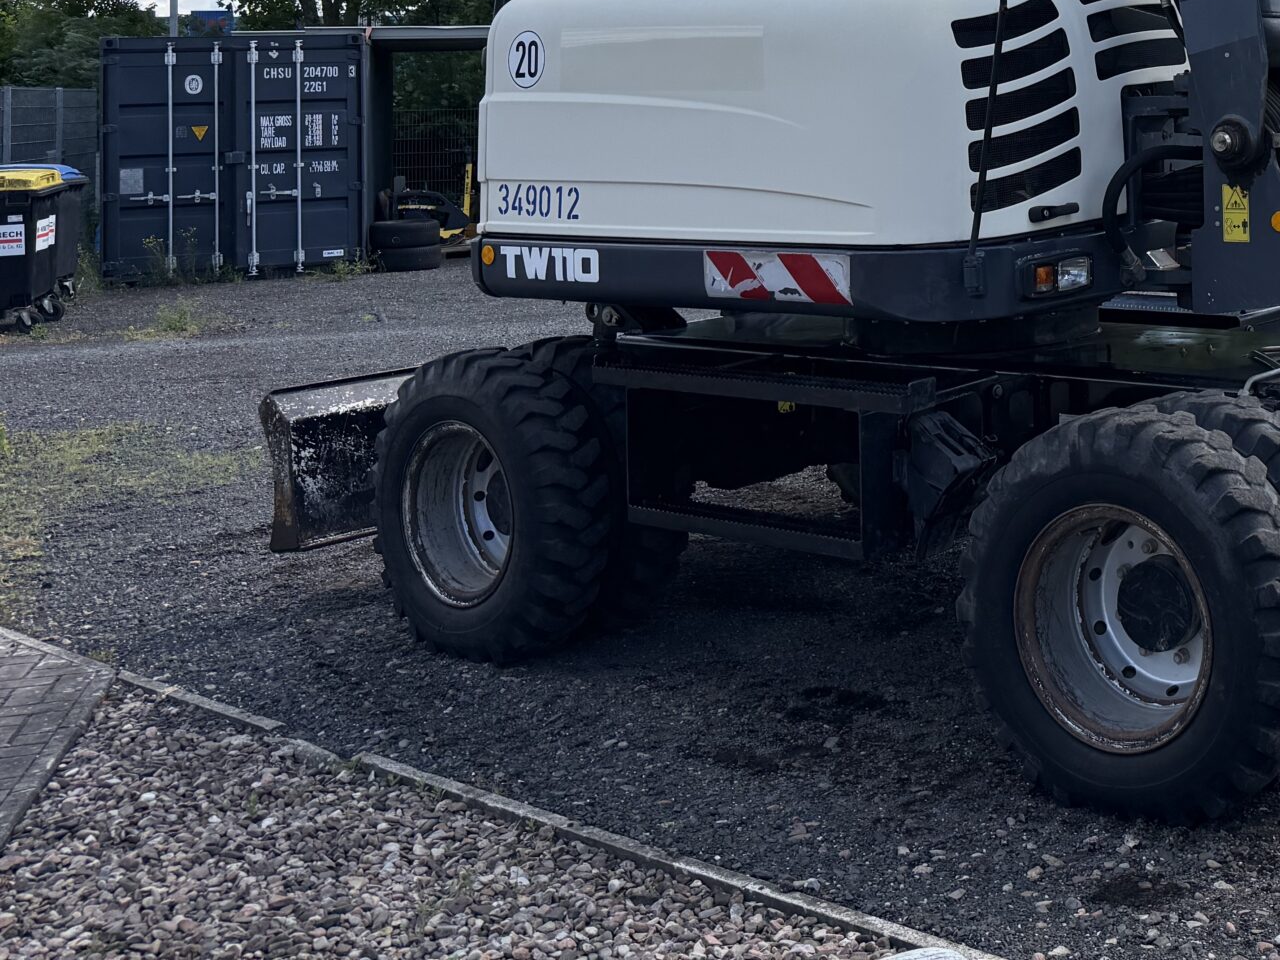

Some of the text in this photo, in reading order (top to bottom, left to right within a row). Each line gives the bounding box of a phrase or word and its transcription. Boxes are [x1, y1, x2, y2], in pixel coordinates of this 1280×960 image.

[515, 41, 539, 79] 20
[263, 65, 356, 79] CHSU 204700 3
[304, 81, 327, 92] 22G1
[260, 115, 292, 127] MAX GROSS
[260, 127, 275, 137] TARE
[260, 137, 287, 148] PAYLOAD
[273, 163, 286, 174] CAP.
[498, 183, 580, 220] 349012
[500, 246, 600, 283] TW110
